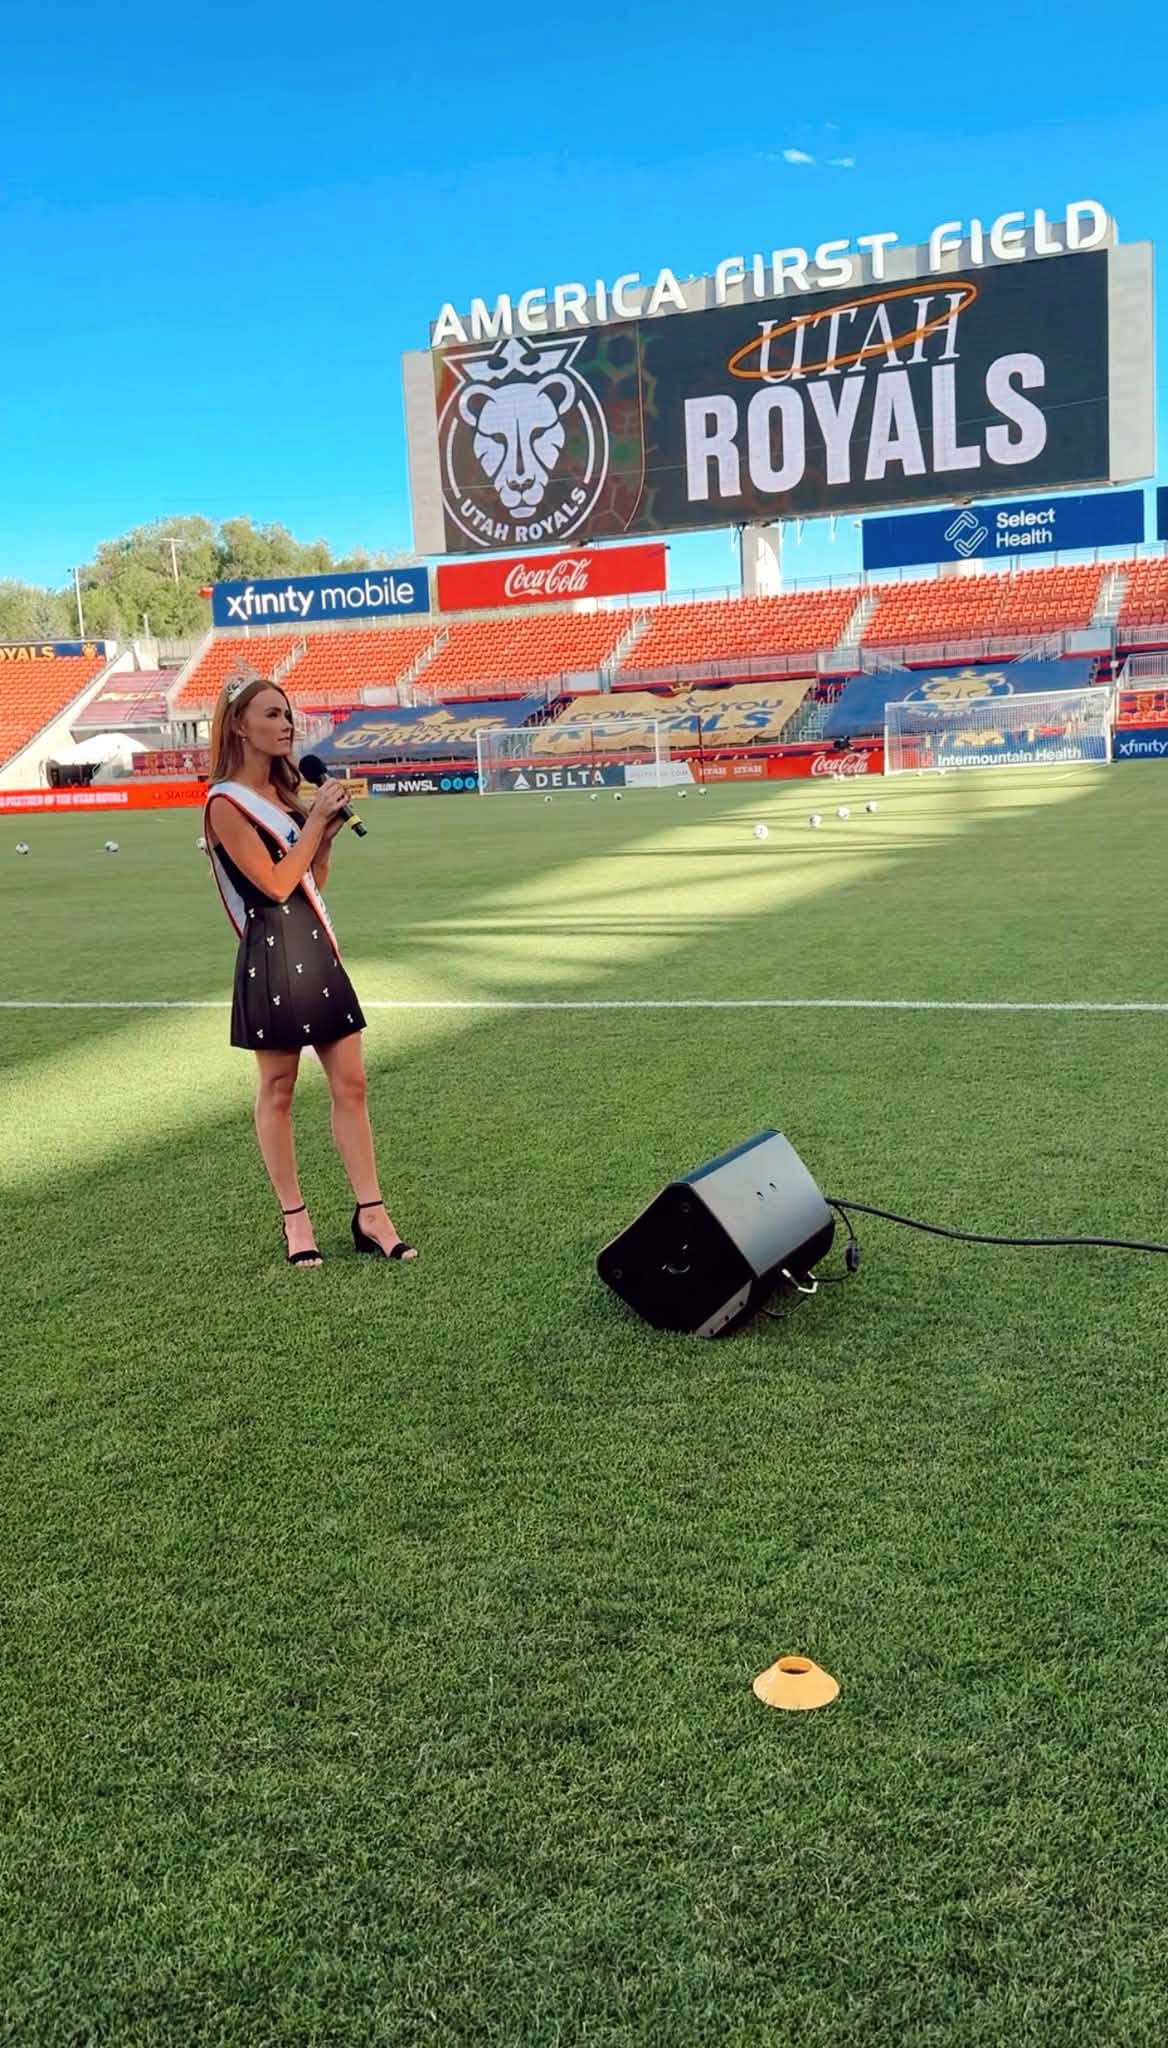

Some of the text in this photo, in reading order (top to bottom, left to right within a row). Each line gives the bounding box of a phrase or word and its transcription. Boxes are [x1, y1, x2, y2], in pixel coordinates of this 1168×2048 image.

[432, 199, 1110, 346] AMERICA FIRST FIELD
[757, 292, 966, 383] UTAH
[685, 353, 1048, 502] ROYALS
[460, 487, 587, 542] UTAH ROYALS
[996, 507, 1056, 529] Select
[996, 528, 1053, 549] Health
[504, 558, 593, 598] Coca-Cola
[226, 576, 414, 620] xfinity mobile
[0, 645, 55, 661] YALS
[811, 750, 871, 776] Coca-Cola
[938, 747, 1082, 767] Intermountain Health
[398, 780, 438, 792] NWSL
[536, 770, 605, 787] DELTA
